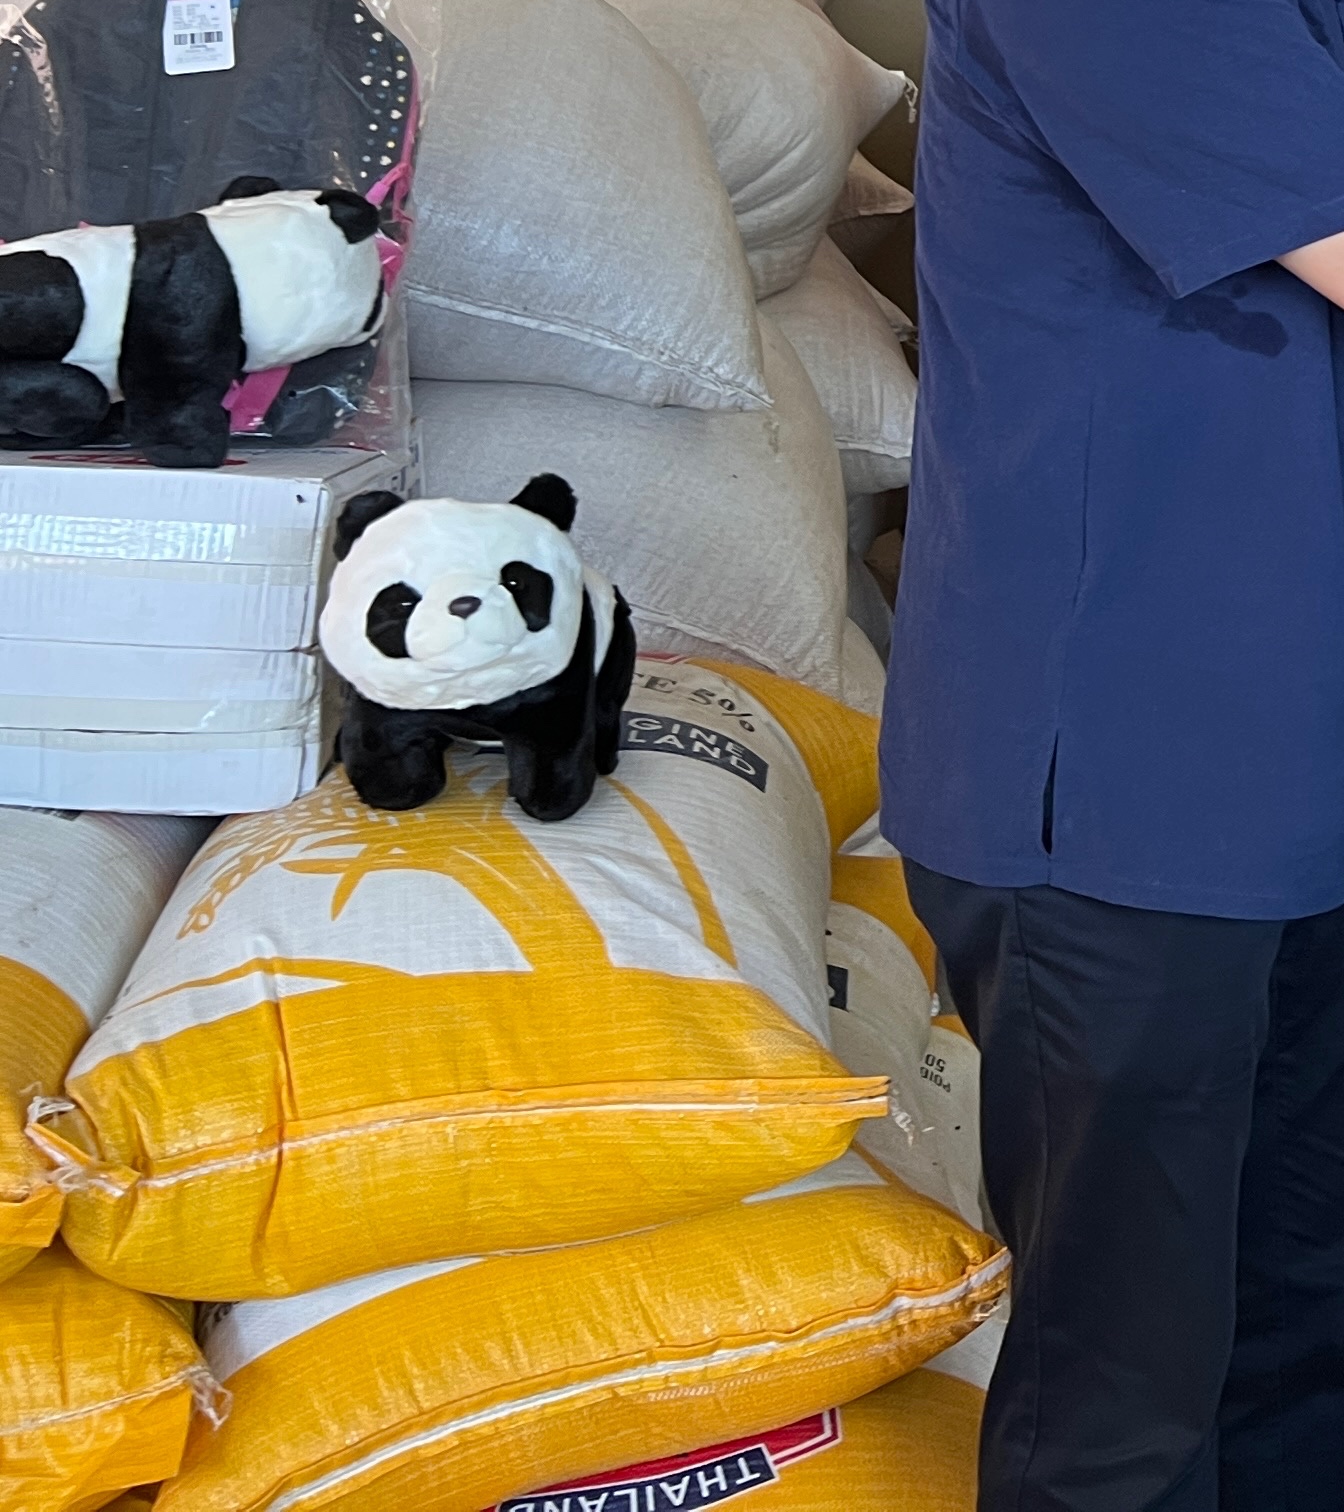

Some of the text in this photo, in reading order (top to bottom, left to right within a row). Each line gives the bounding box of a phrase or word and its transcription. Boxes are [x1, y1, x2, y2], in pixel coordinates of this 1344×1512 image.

[688, 688, 755, 733] 5%
[627, 730, 757, 776] LAND
[628, 717, 745, 758] GINE
[920, 1066, 951, 1093] POID
